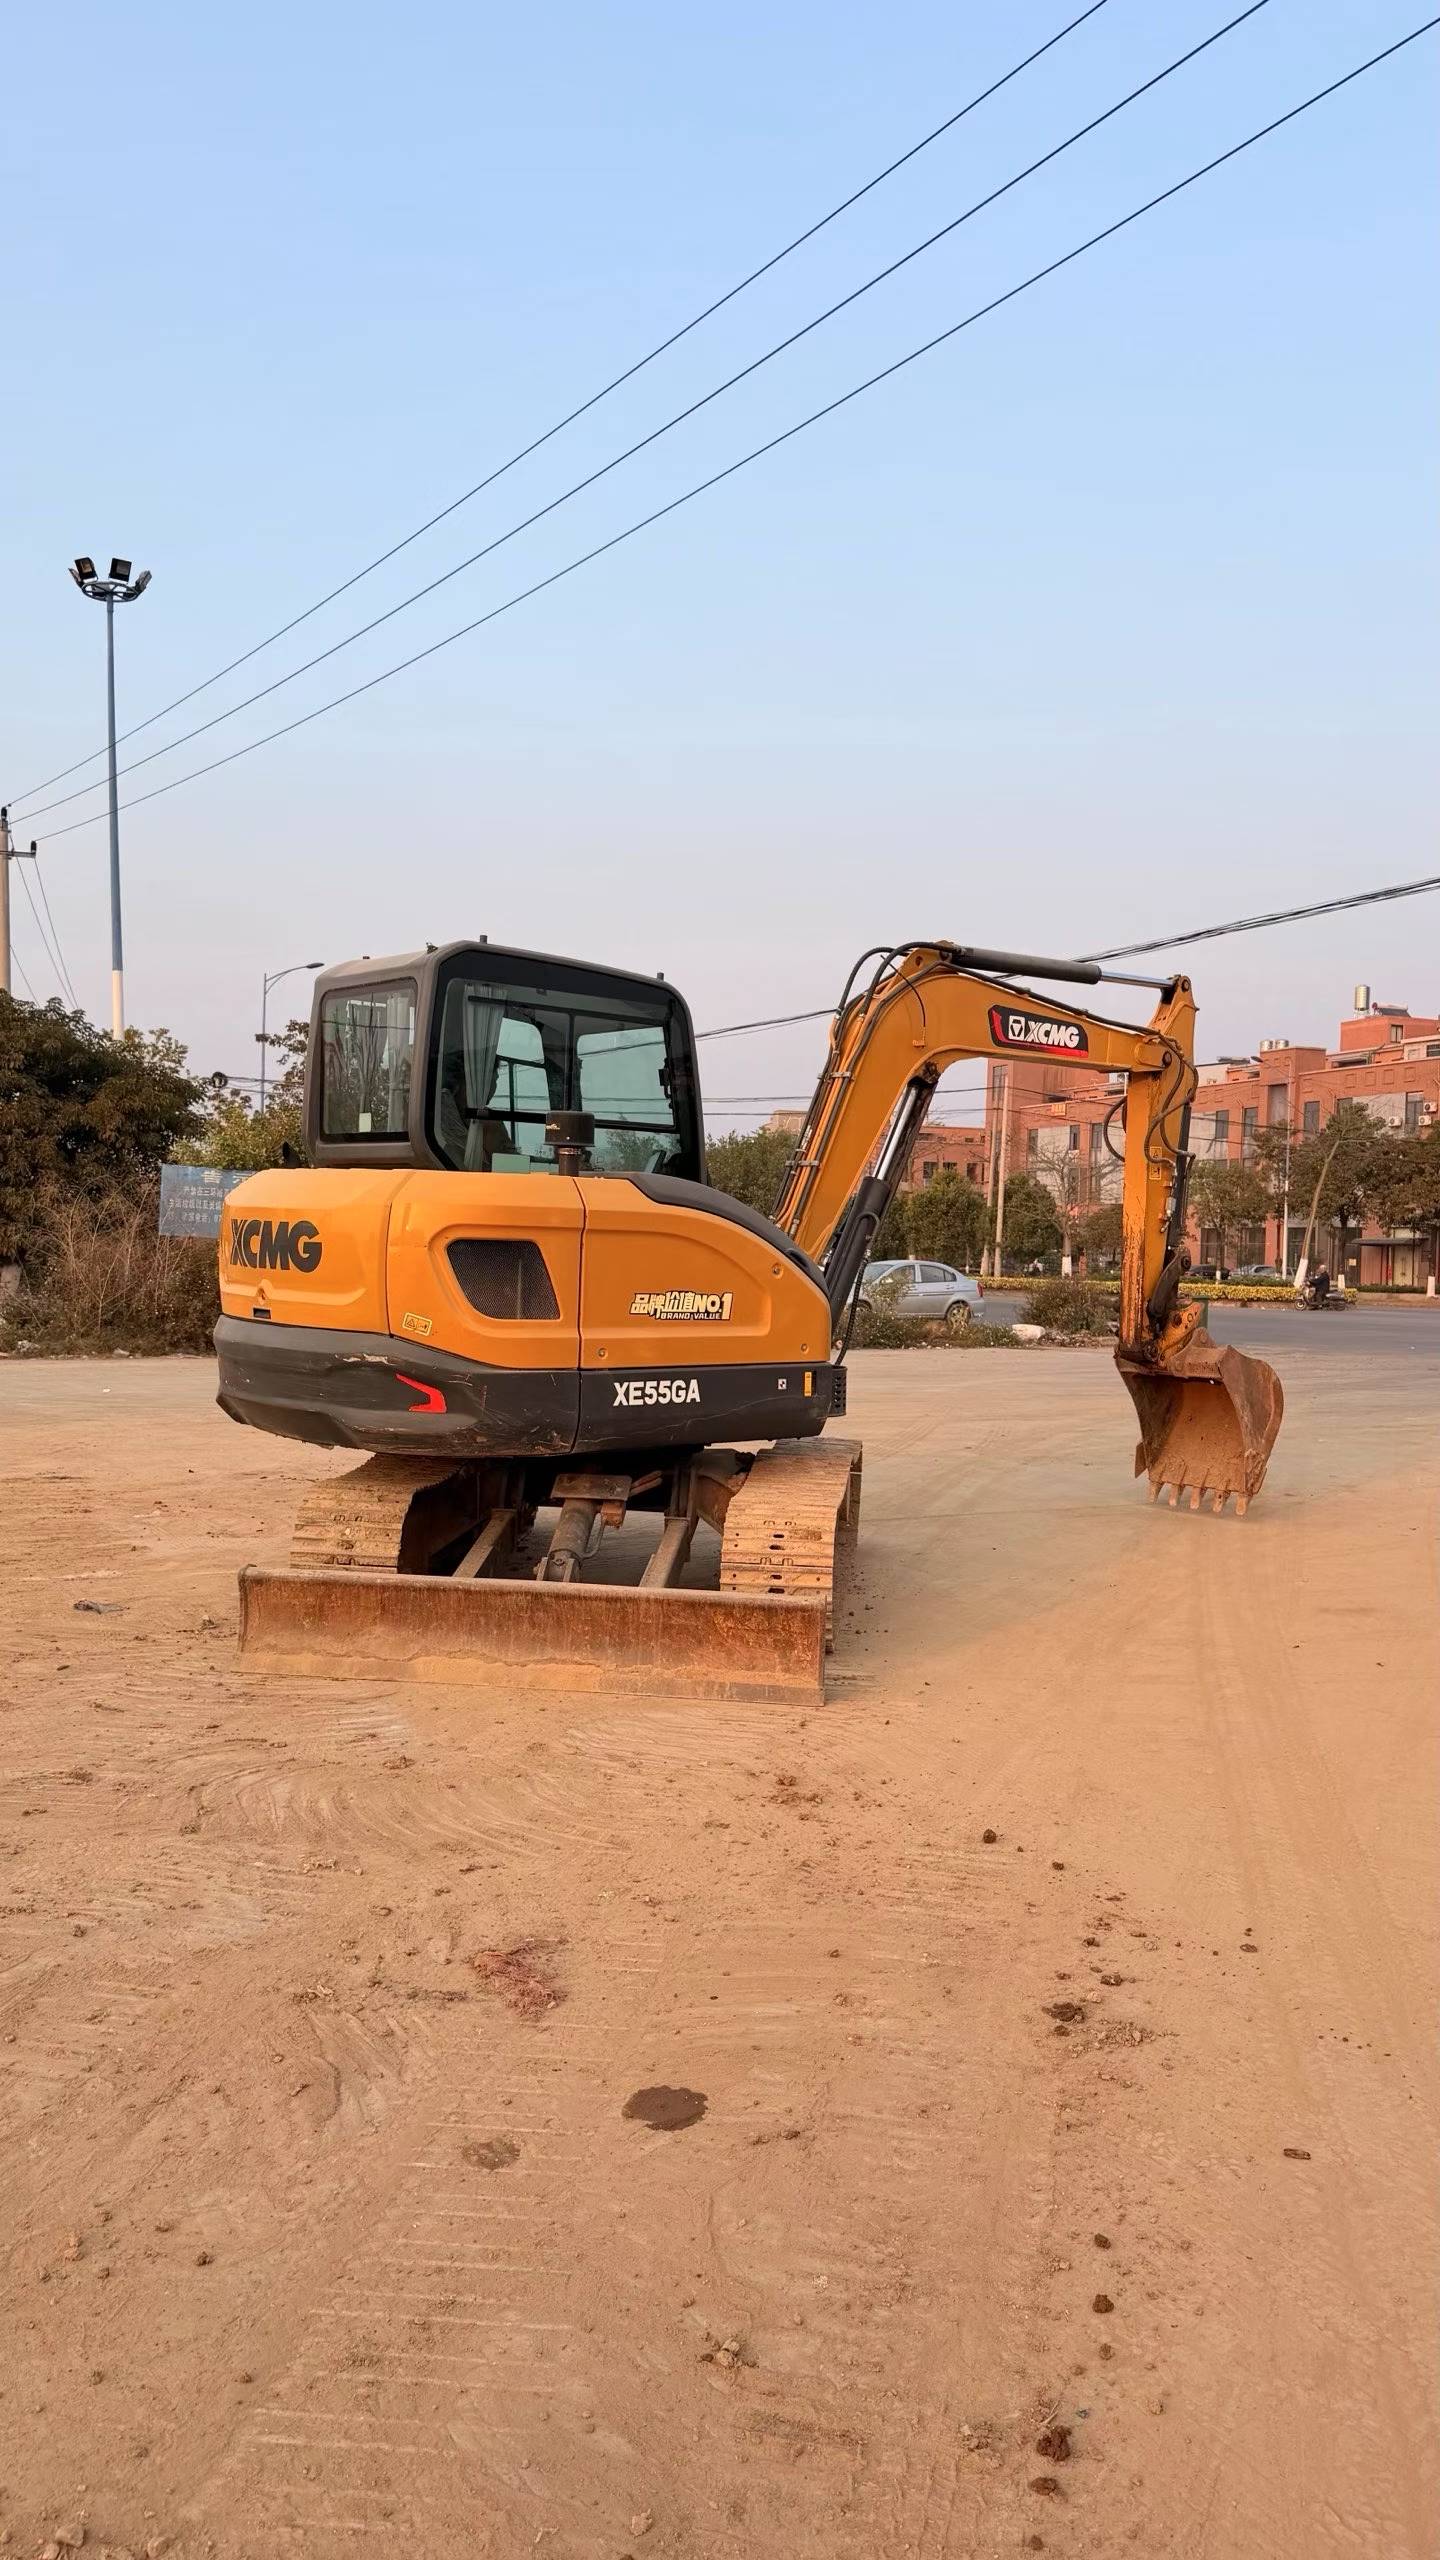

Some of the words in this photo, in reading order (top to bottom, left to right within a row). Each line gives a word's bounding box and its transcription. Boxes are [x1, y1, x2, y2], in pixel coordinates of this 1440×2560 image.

[1024, 1020, 1079, 1048] XCMG
[230, 1218, 322, 1273] XCMG
[661, 1312, 691, 1320] BRAND
[694, 1312, 721, 1320] VALUE
[613, 1379, 701, 1406] XE55GA
